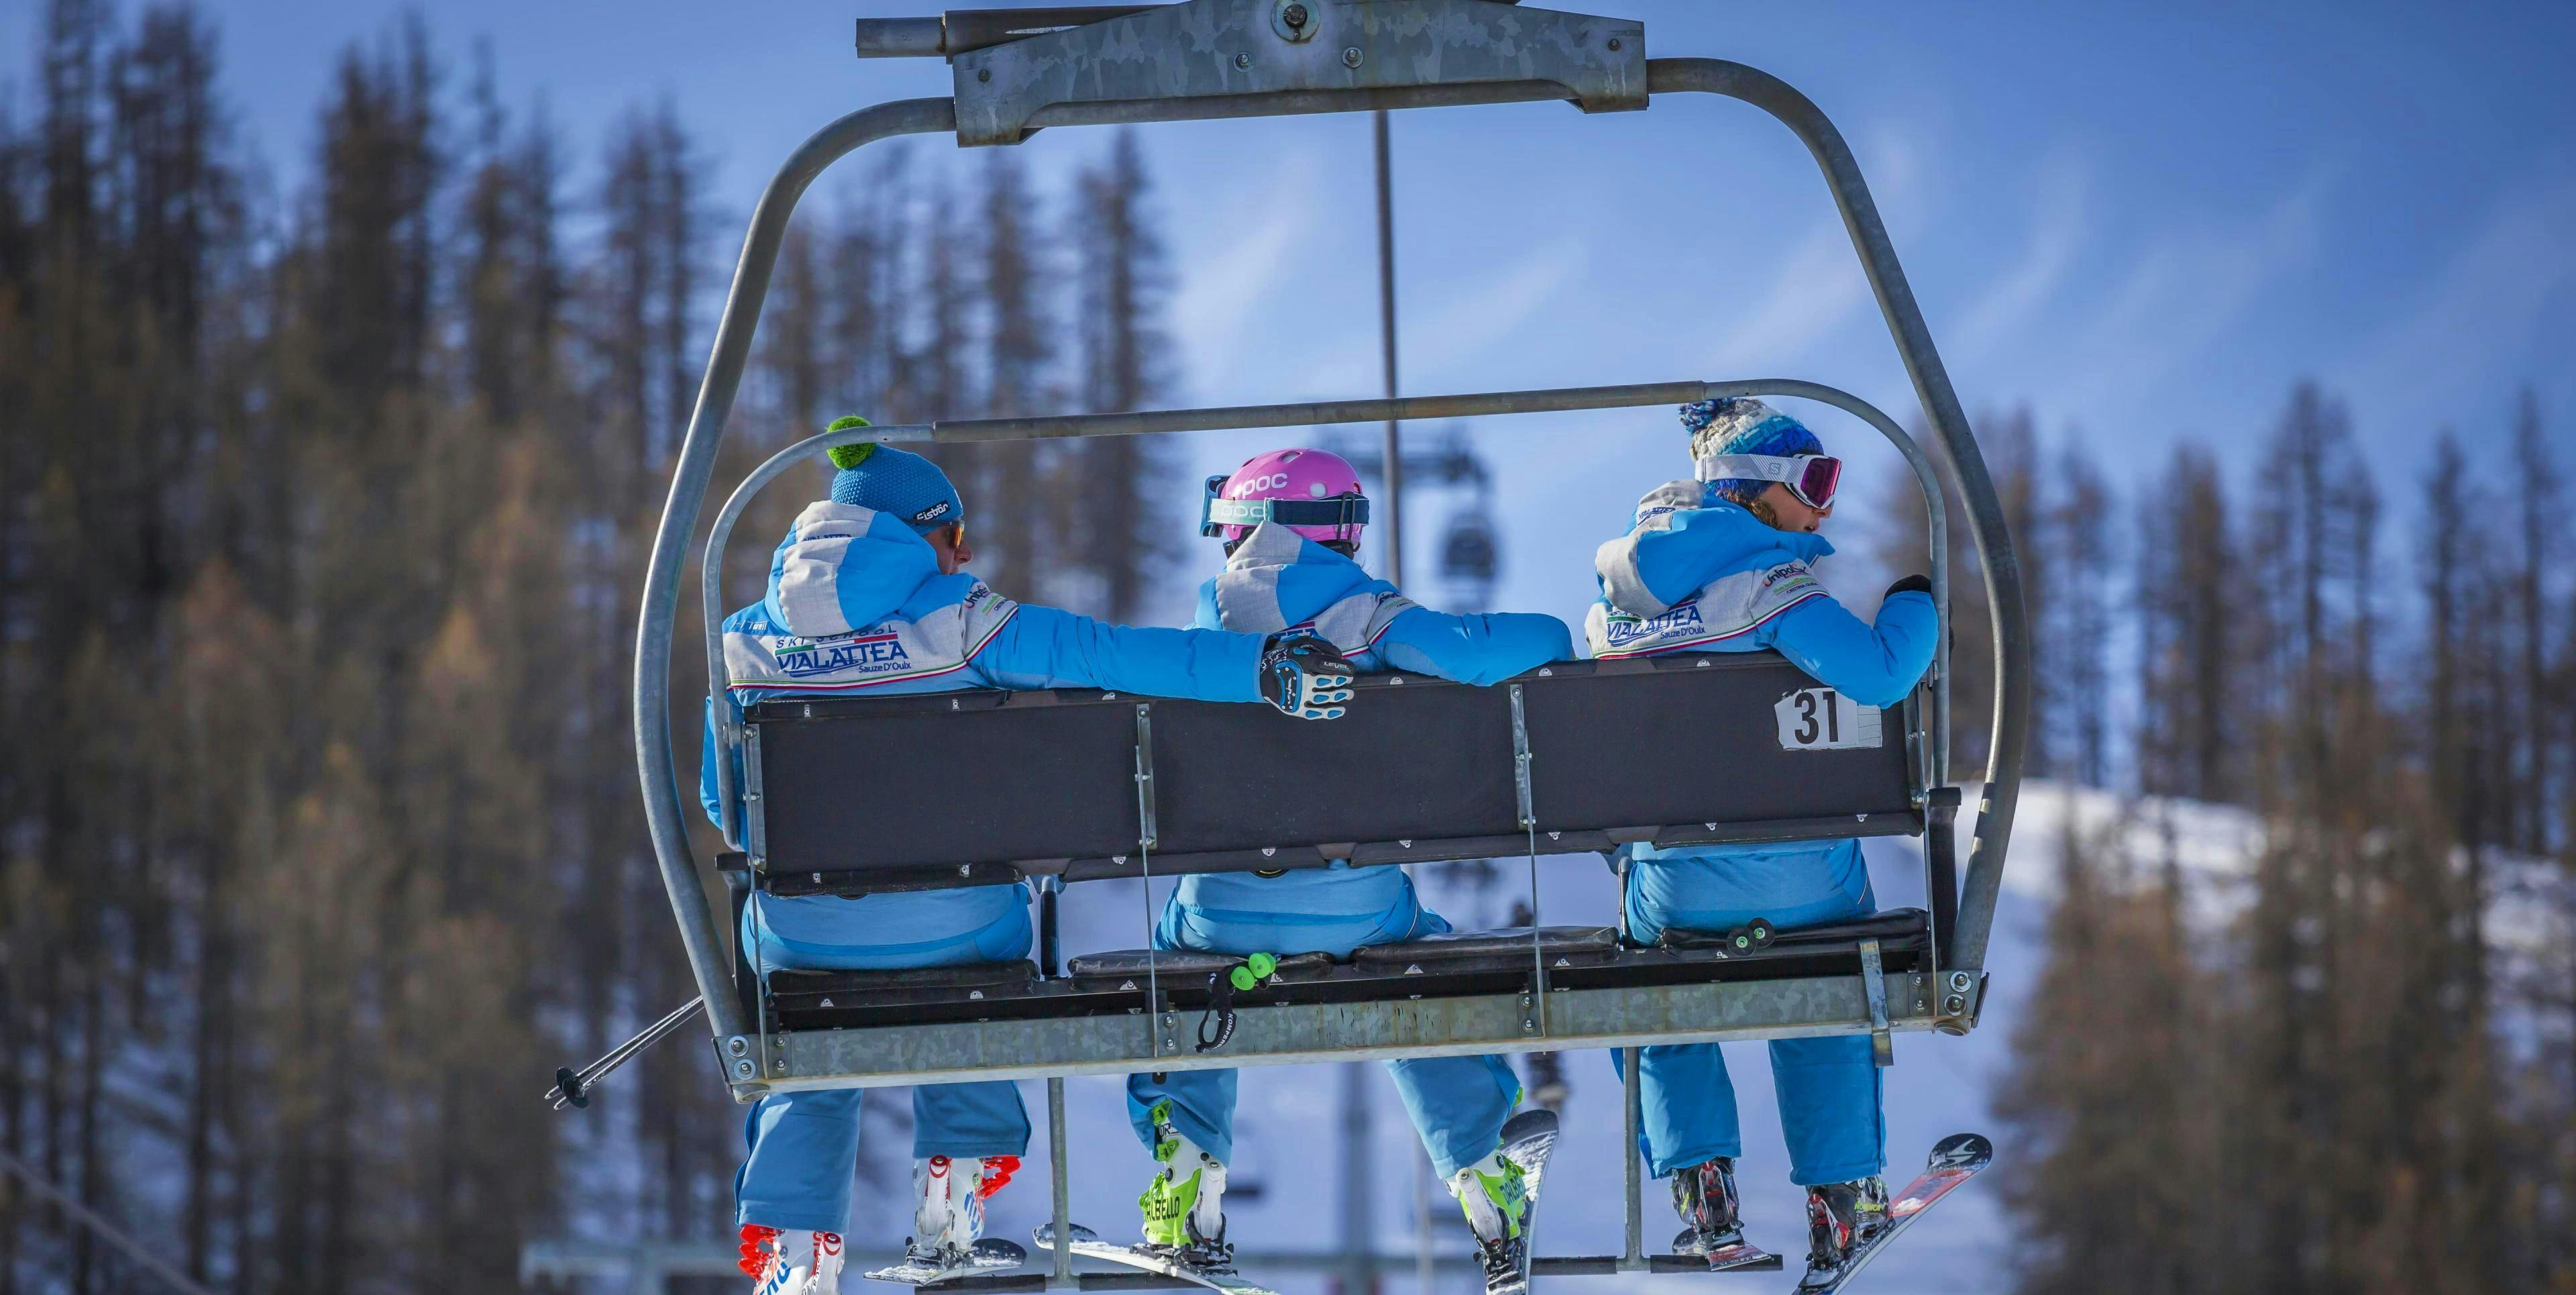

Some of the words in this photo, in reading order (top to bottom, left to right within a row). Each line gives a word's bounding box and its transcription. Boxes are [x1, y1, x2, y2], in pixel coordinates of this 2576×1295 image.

[777, 640, 909, 670] VIALATTEA
[1324, 661, 1350, 670] LEVEL
[1794, 691, 1839, 745] 31
